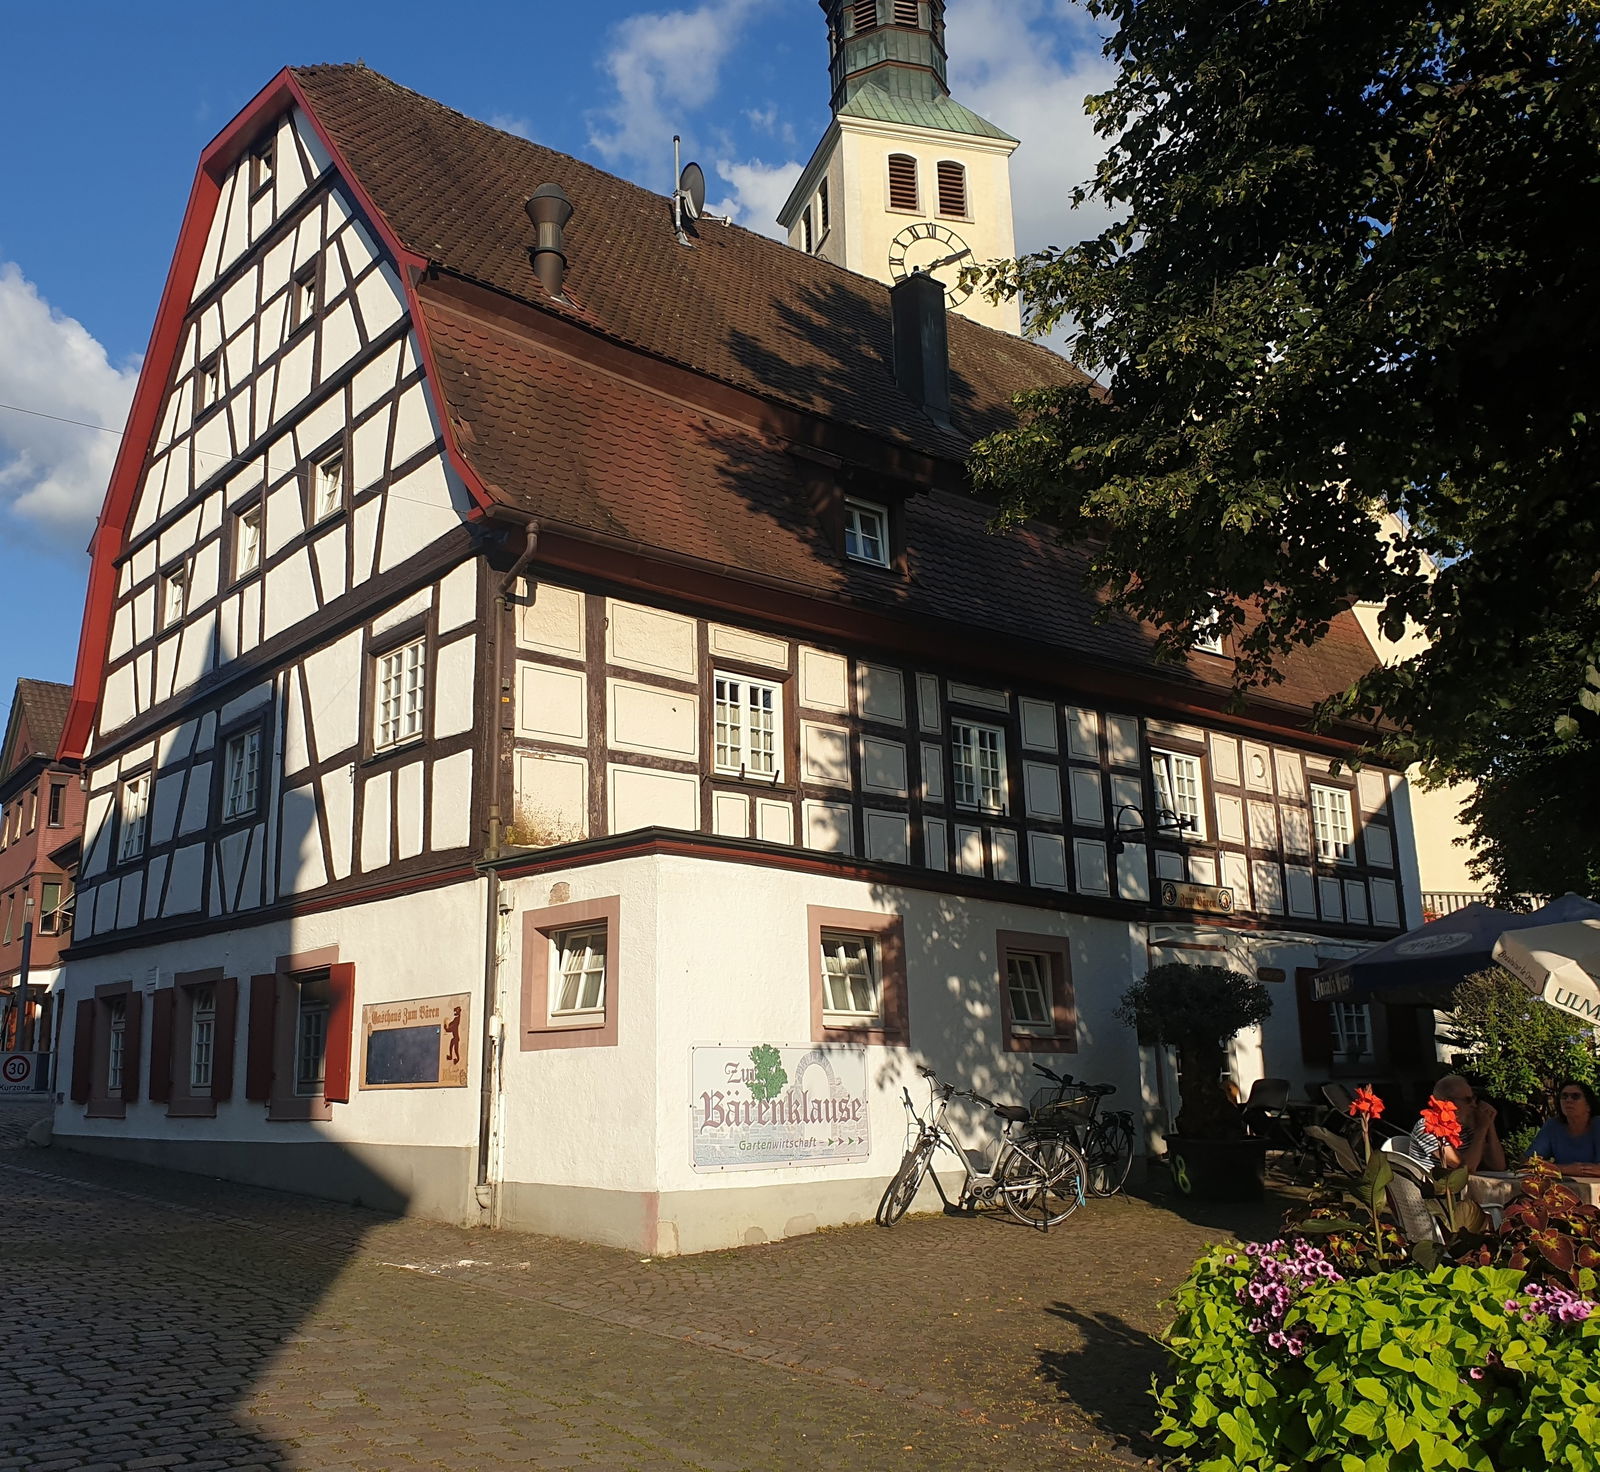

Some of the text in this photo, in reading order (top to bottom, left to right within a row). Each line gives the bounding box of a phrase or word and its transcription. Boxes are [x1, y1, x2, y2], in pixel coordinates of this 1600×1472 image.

[418, 1005, 440, 1019] Bären
[8, 1062, 25, 1075] 30
[700, 1089, 862, 1135] Bärenklause
[739, 1136, 817, 1151] Gartenwirtschaft
